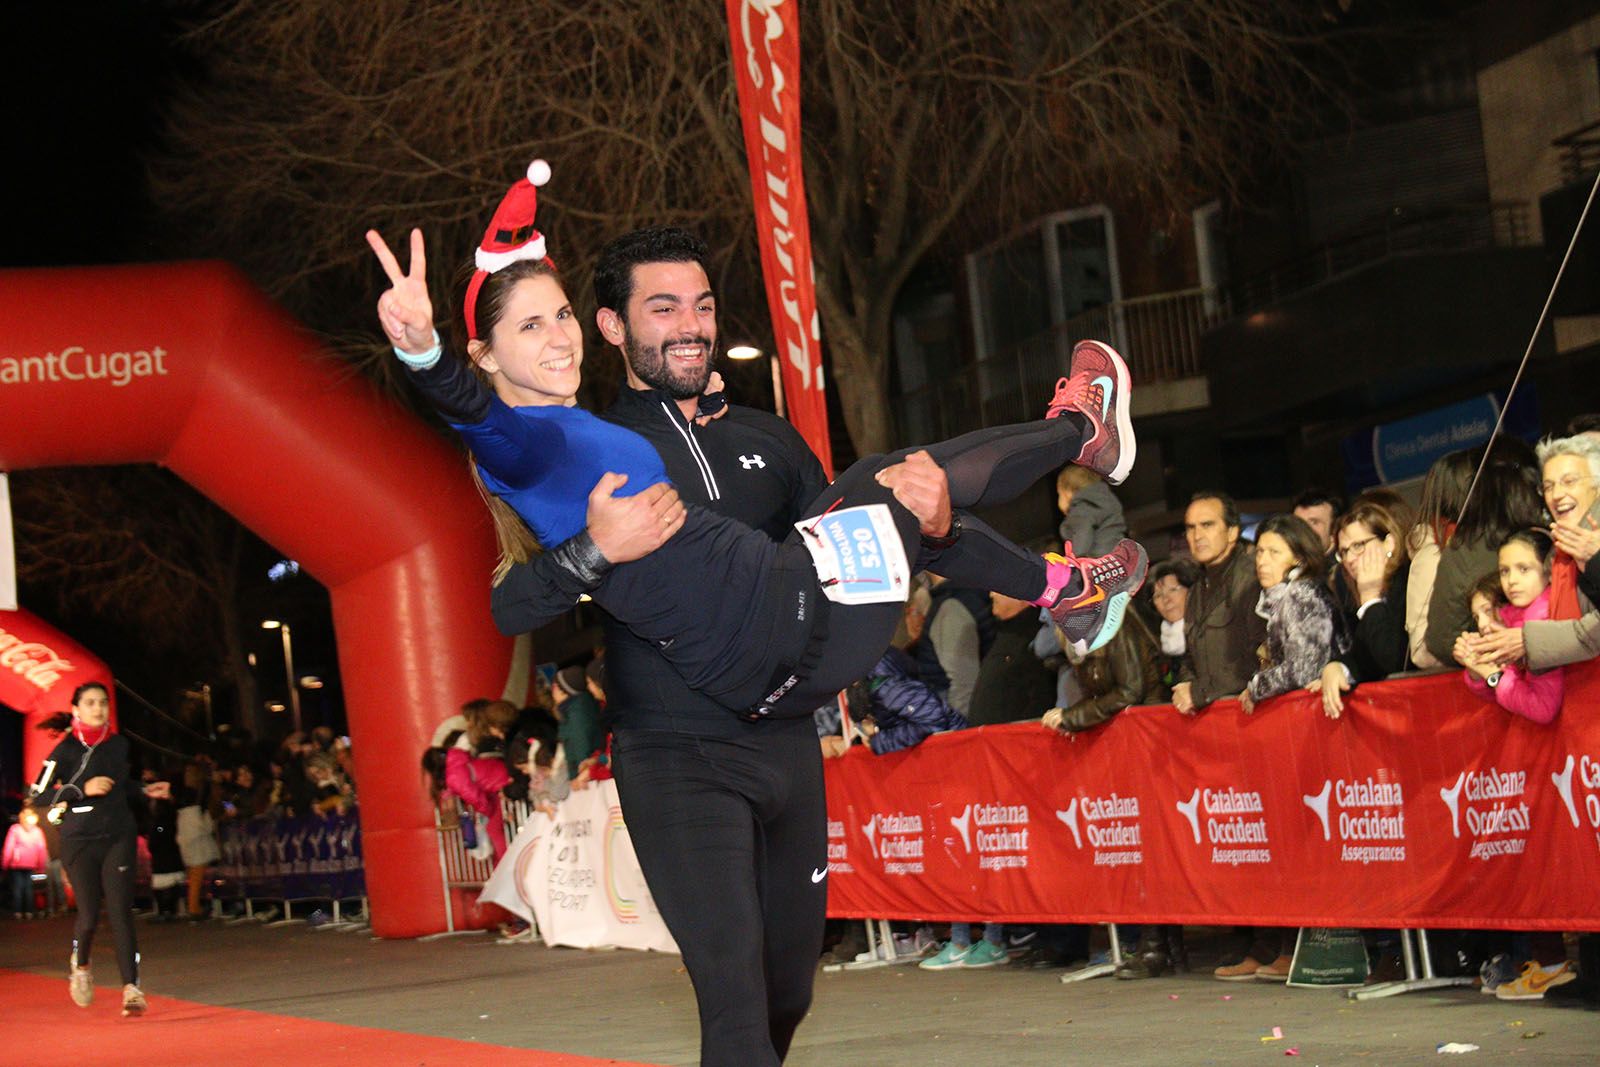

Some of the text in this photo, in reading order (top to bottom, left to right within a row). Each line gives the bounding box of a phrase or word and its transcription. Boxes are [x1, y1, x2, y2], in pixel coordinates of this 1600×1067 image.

[828, 520, 858, 584] CAROLINA
[852, 527, 880, 568] 520
[1336, 777, 1403, 808] Catalana
[1465, 767, 1526, 801] Catalana
[1081, 793, 1139, 821] Catalana
[1203, 786, 1264, 814] Catalana
[1087, 821, 1141, 847] Occident
[1208, 816, 1268, 843] Occident
[1339, 810, 1405, 840] Occident
[1212, 846, 1271, 866] Assegurances
[1341, 843, 1406, 864] Assegurances
